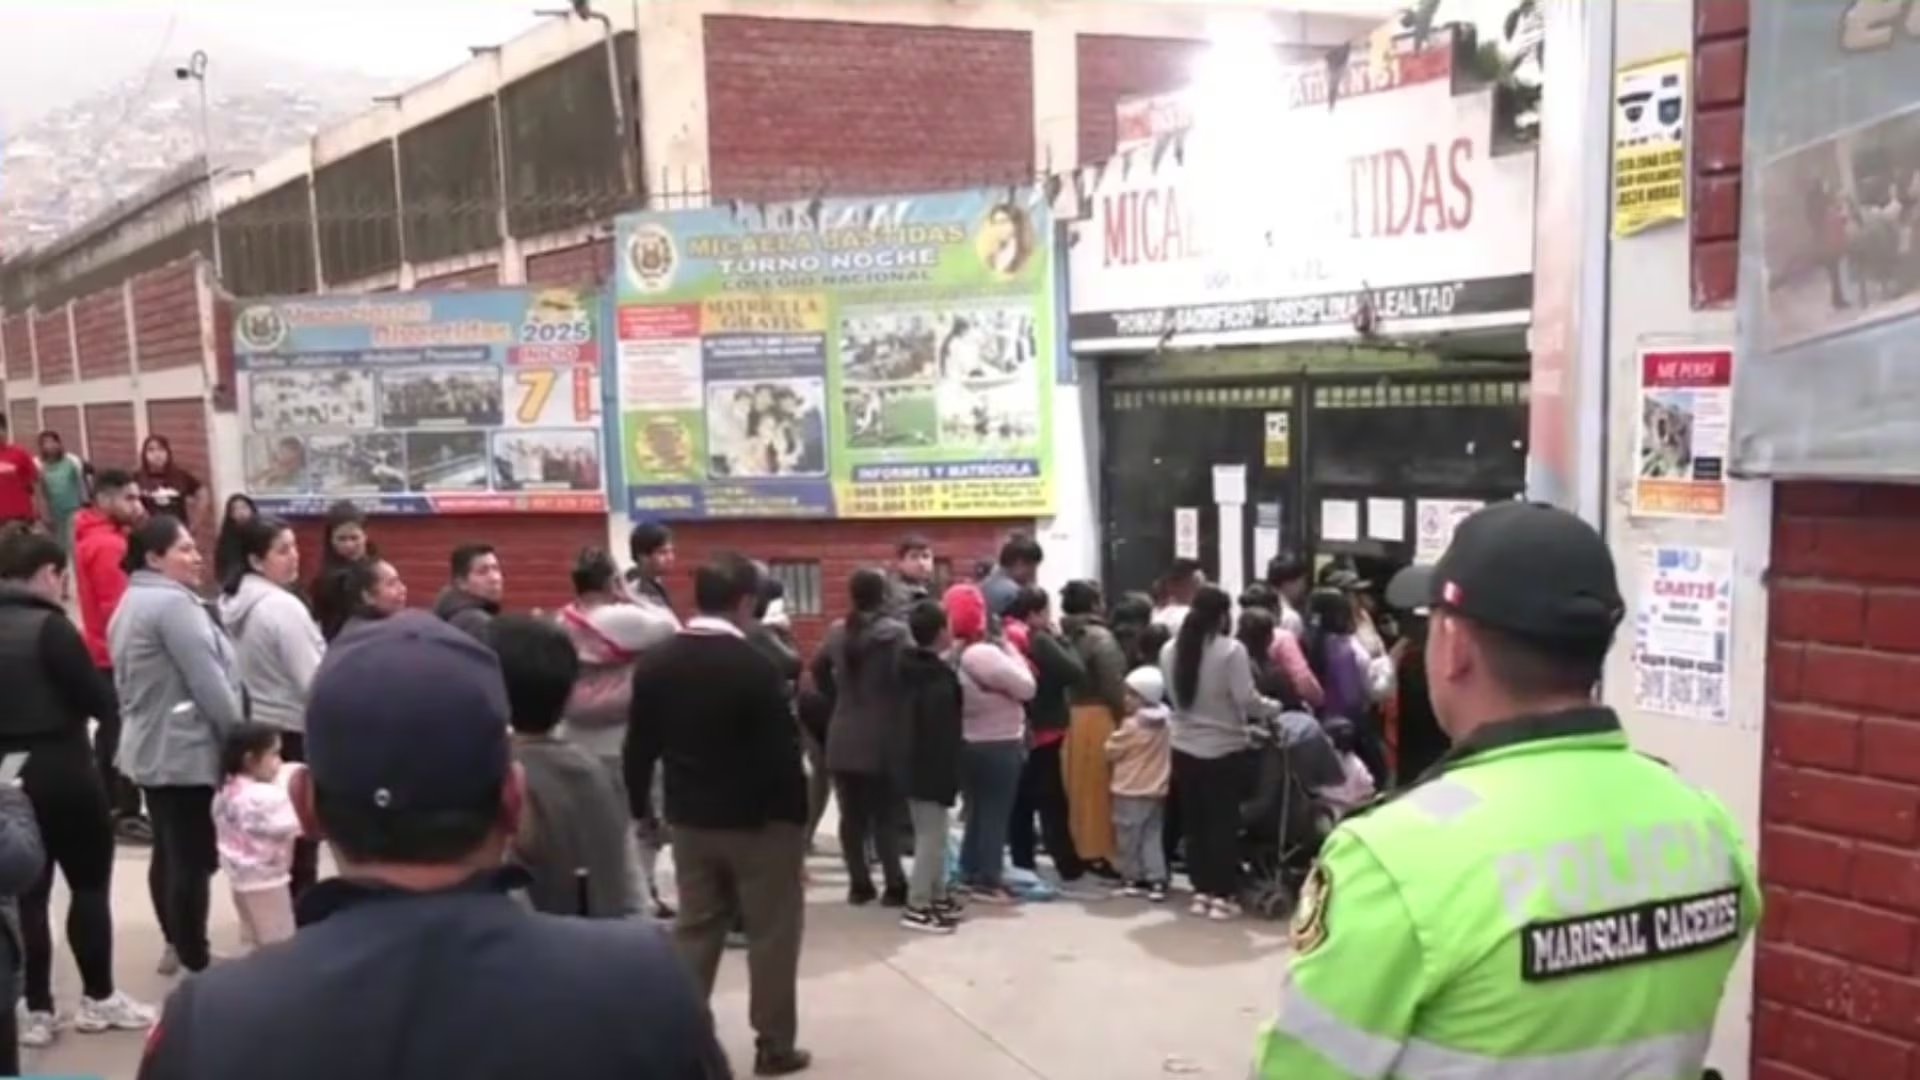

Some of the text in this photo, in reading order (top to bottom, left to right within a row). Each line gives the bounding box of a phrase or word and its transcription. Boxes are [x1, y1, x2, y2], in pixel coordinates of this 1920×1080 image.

[1347, 137, 1474, 240] TIDAS
[719, 248, 938, 275] TURNO NOCHE
[721, 268, 932, 291] COLEGIO NACIONAL
[522, 321, 589, 343] 2025
[516, 368, 557, 424] 7
[1653, 580, 1716, 600] GRATIS
[1530, 891, 1738, 974] MARISCAL CACERES
